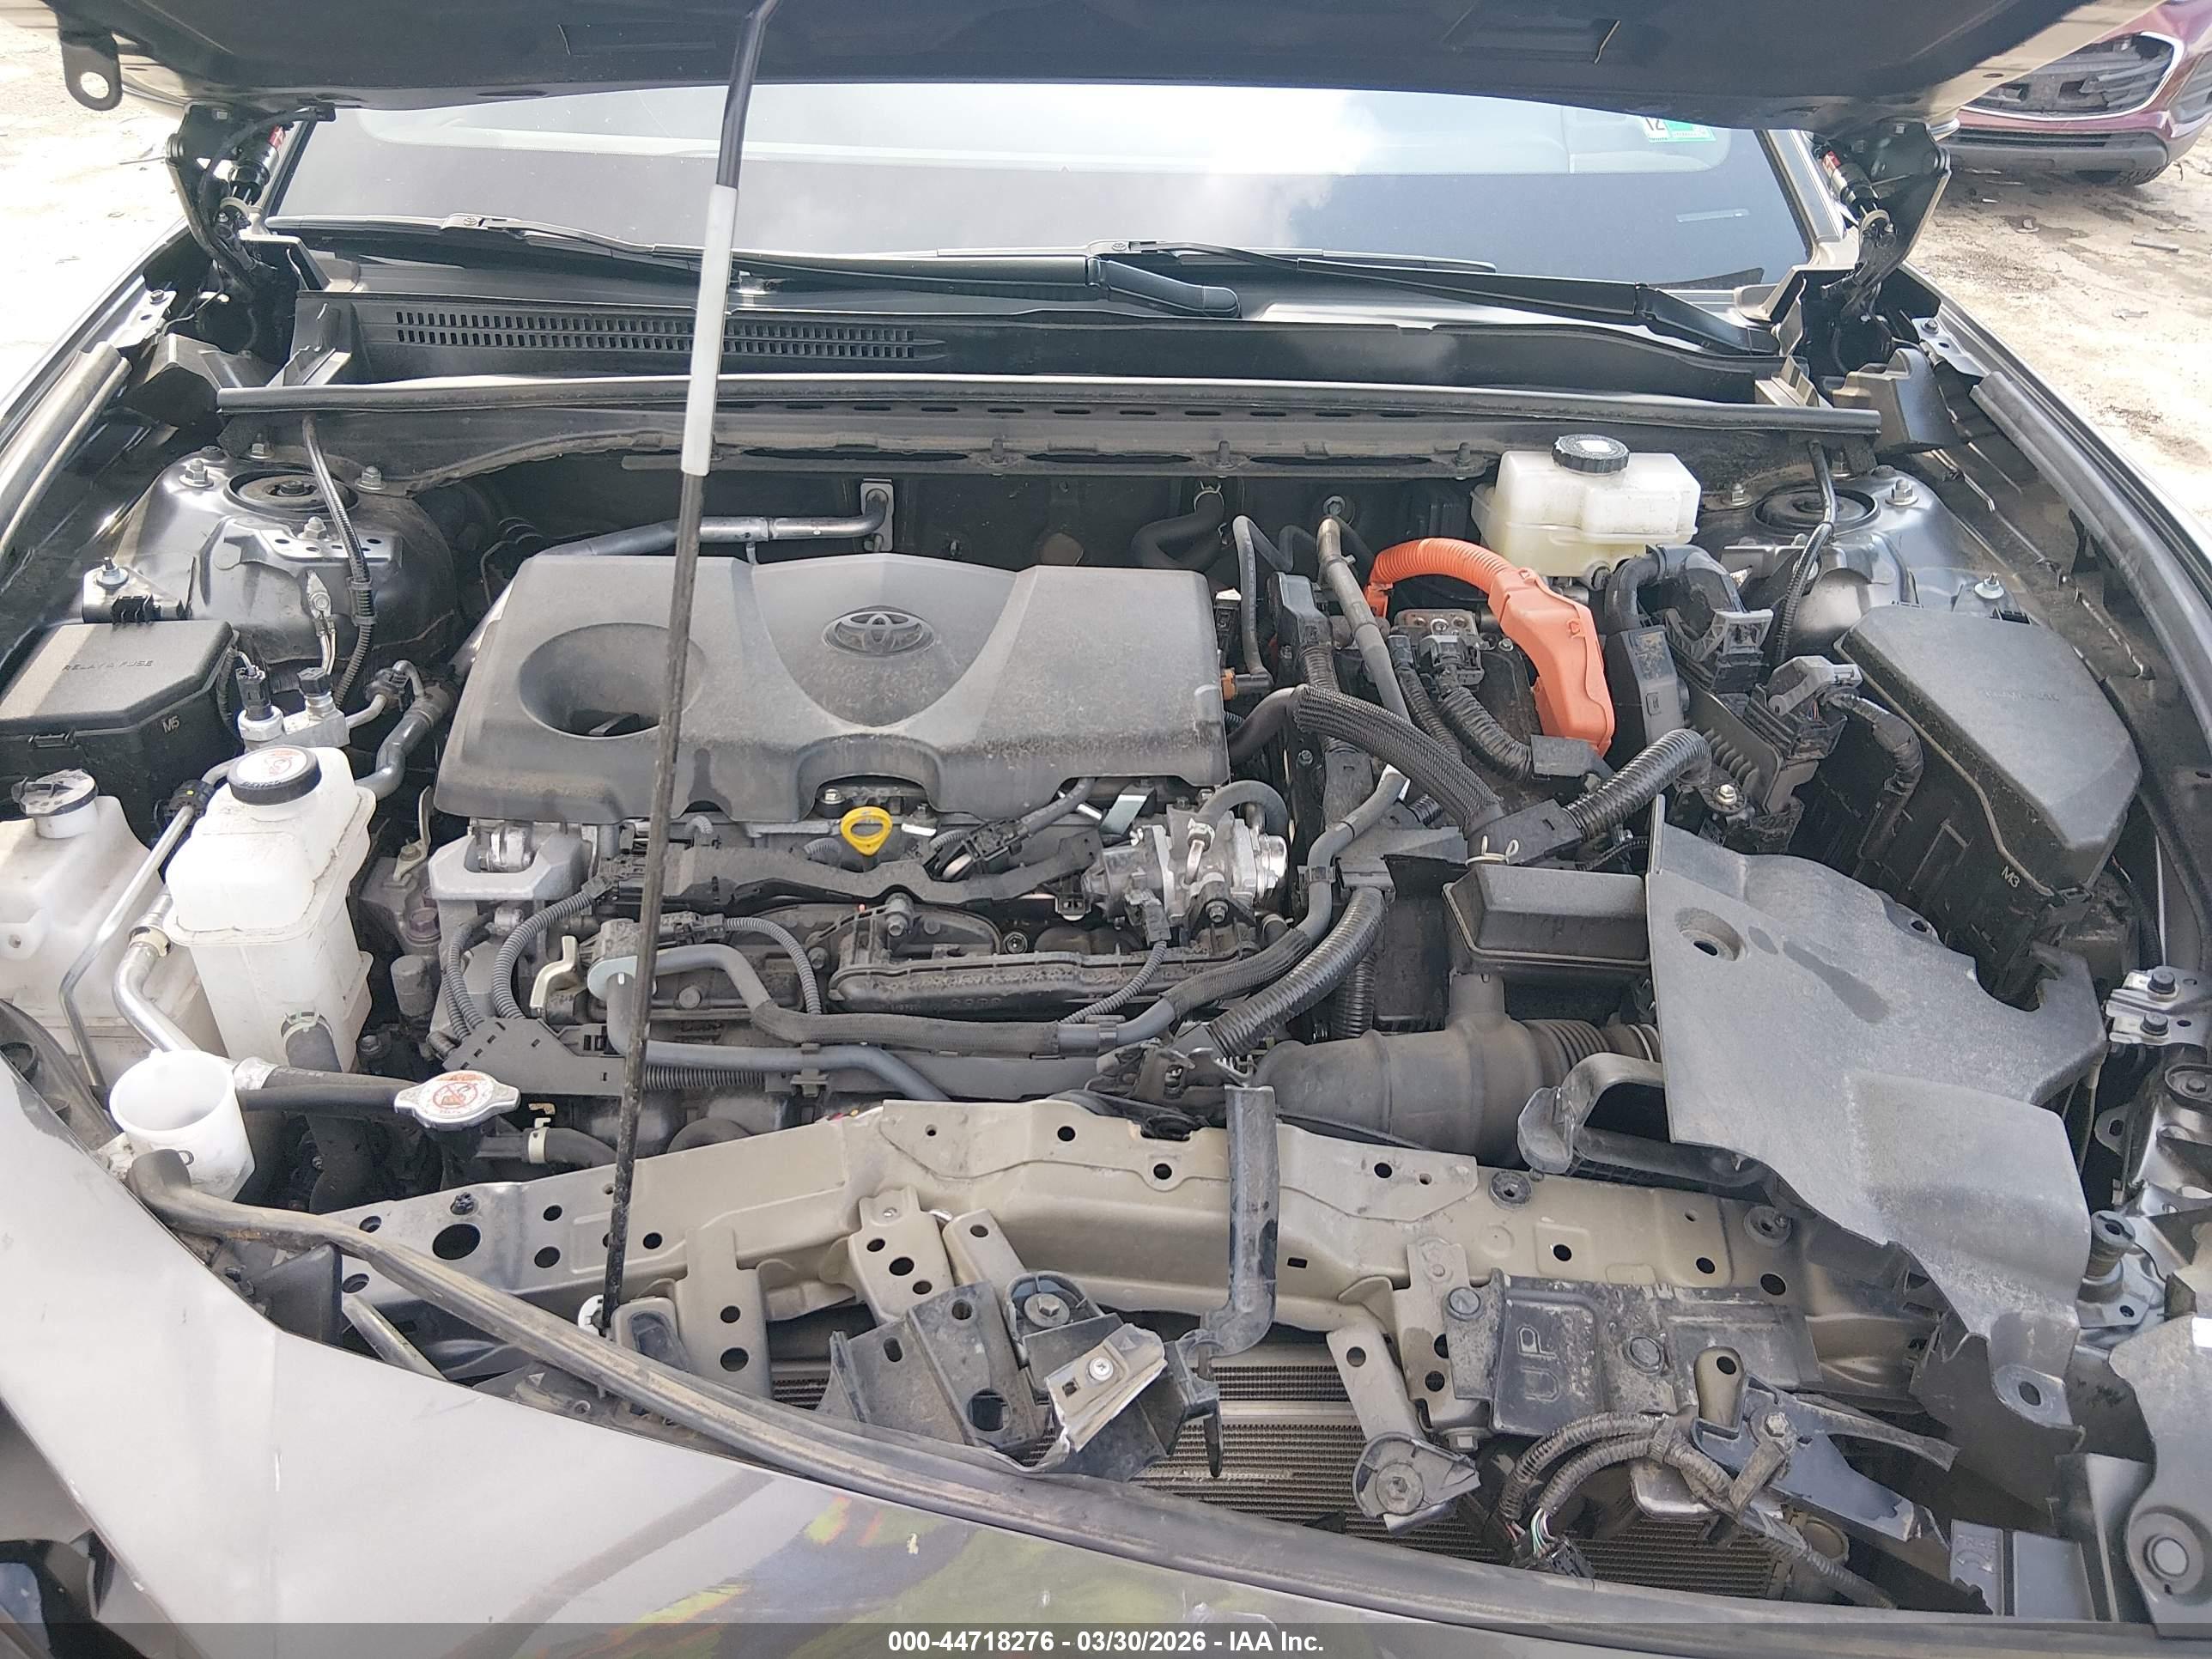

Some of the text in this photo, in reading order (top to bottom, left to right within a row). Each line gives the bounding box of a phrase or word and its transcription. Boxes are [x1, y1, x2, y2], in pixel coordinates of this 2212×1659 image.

[118, 659, 154, 668] FUSE
[162, 715, 180, 733] M5
[2001, 865, 2021, 888] M3
[1516, 1323, 1560, 1403] UP
